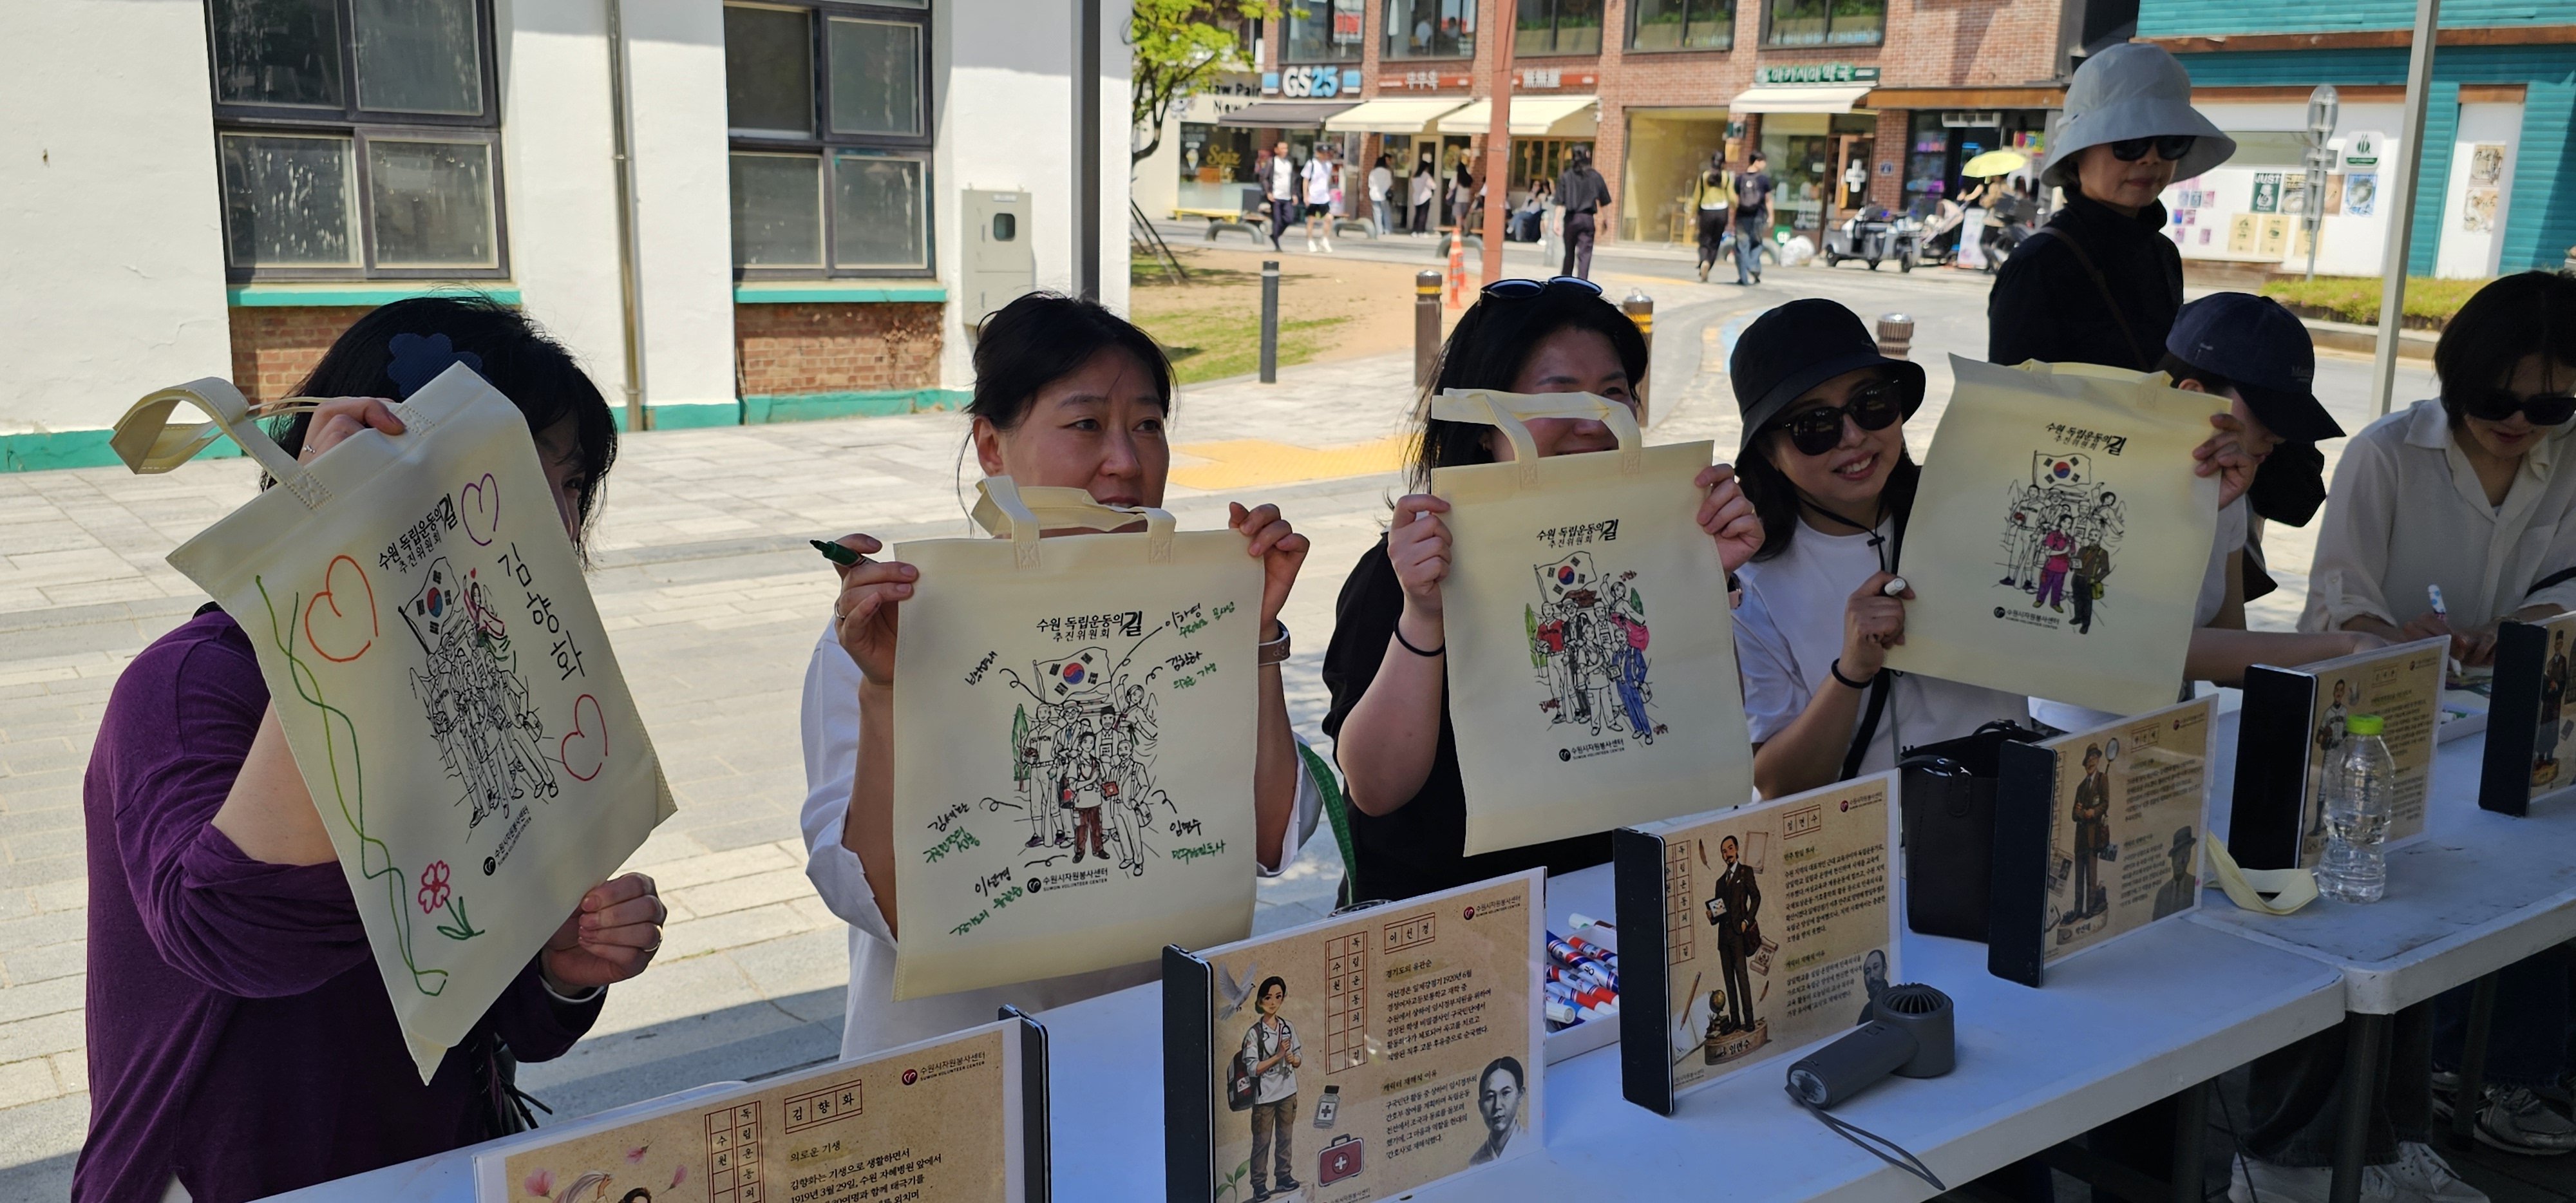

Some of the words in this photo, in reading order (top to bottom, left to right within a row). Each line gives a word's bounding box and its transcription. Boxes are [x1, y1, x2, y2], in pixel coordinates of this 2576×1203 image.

[1282, 66, 1338, 97] GS25
[2255, 173, 2282, 184] JUST
[2045, 422, 2065, 435] 수원
[2067, 427, 2110, 443] 독립운동의
[2102, 435, 2127, 456] 길
[379, 545, 401, 571] 수원
[399, 505, 443, 552] 독립운동의
[439, 493, 458, 534] 길
[1537, 527, 1555, 541] 수원
[1559, 522, 1604, 537] 독립운동의
[1599, 519, 1619, 541] 길
[1548, 535, 1592, 548] 추진위원회
[398, 531, 442, 573] 추진위원회
[498, 542, 585, 680] 김향화
[1036, 617, 1061, 632] 수원
[1065, 614, 1123, 629] 독립운동의
[1118, 611, 1143, 636] 길
[1053, 627, 1110, 642] 추진위원회
[1043, 867, 1108, 884] 수원시자원봉사센터
[1390, 922, 1429, 943] 이선경
[1387, 965, 1410, 978] 경기도의
[1413, 960, 1432, 971] 유관순
[1729, 1039, 1750, 1055] 임면수
[920, 1051, 985, 1074] 수원시자원봉사센터
[793, 1092, 855, 1121] 김향화
[717, 1135, 728, 1166] 수원
[740, 1108, 755, 1198] 독립운동의
[791, 1148, 819, 1161] 의로운
[823, 1141, 840, 1152] 기생
[791, 1174, 826, 1191] 김향화는
[829, 1162, 864, 1180] 기생으로
[867, 1148, 909, 1168] 생활하면서
[791, 1189, 819, 1203] 1919년
[820, 1184, 834, 1197] 3월
[837, 1179, 858, 1191] 29일,
[860, 1173, 877, 1184] 수원
[880, 1162, 914, 1179] 자혜병원
[916, 1153, 941, 1170] 앞에서
[871, 1184, 887, 1197] 함께
[891, 1174, 924, 1189] 태극기를
[895, 1189, 918, 1203] 외치며
